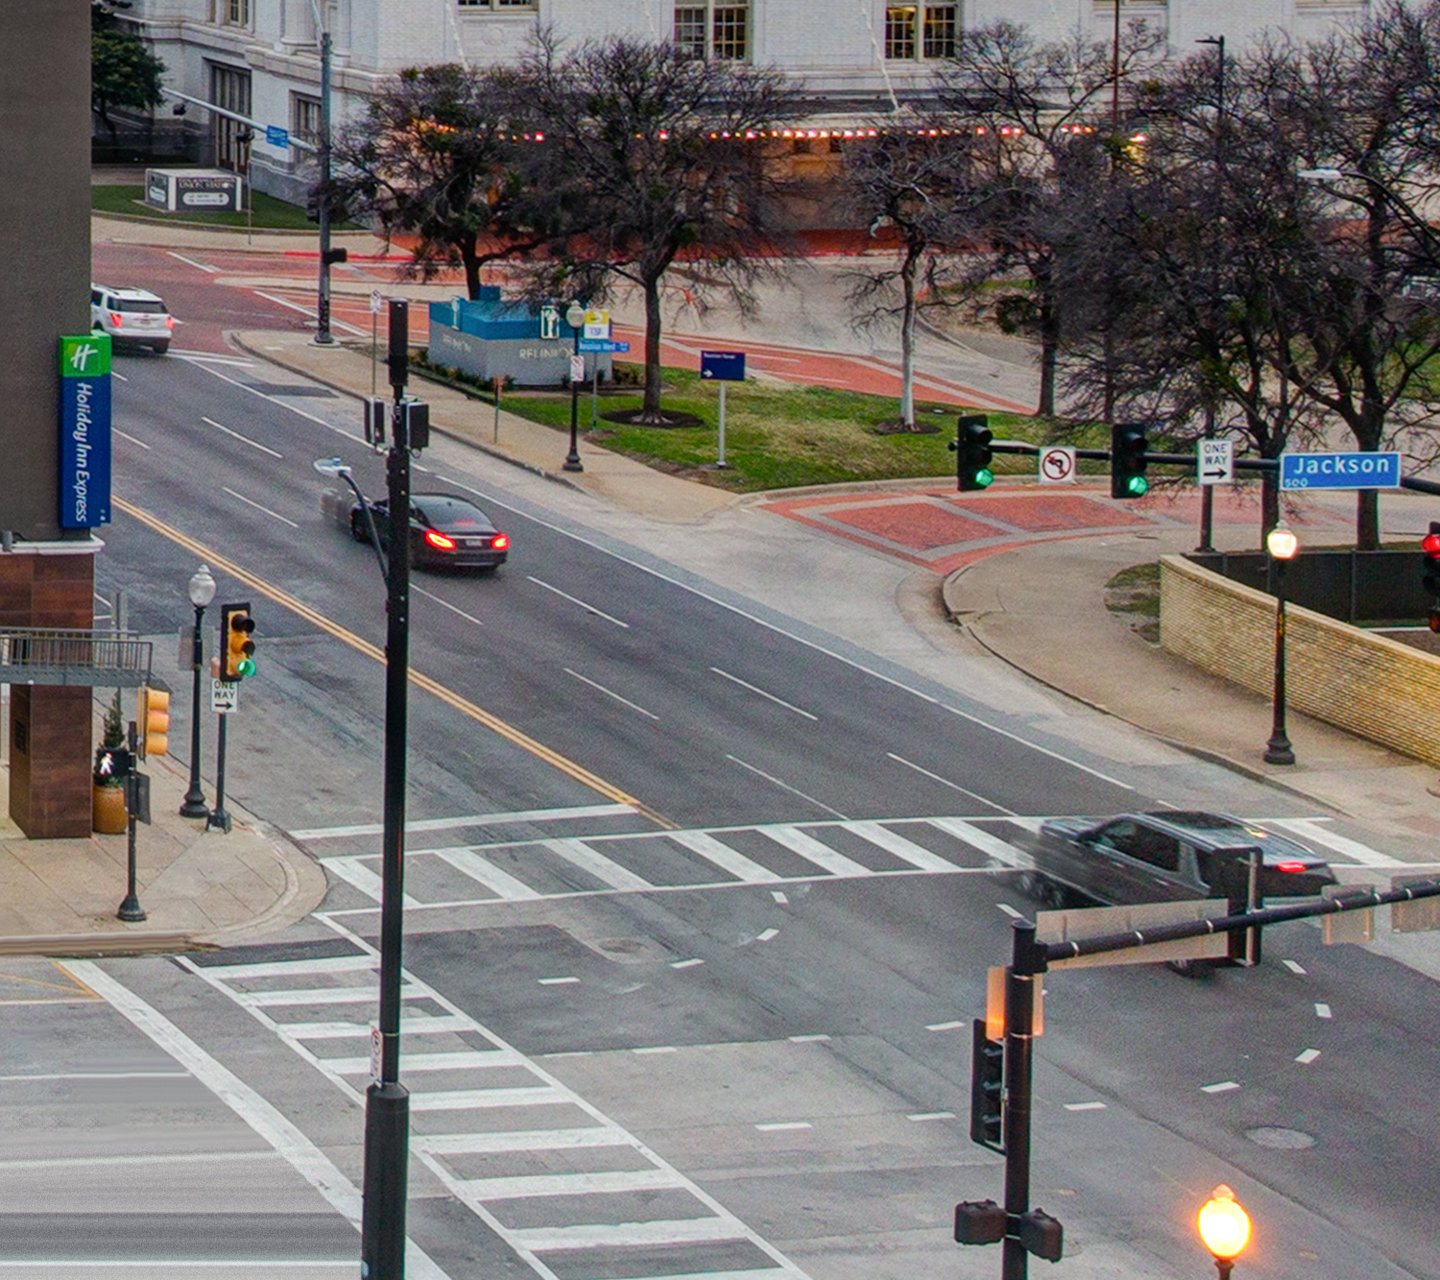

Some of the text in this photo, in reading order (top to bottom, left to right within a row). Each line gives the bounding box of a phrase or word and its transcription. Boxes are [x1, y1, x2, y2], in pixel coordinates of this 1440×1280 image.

[73, 382, 92, 522] Holiday Inn Express
[1204, 443, 1227, 454] ONE
[1205, 455, 1228, 465] WAY
[1293, 456, 1389, 474] Jackson
[214, 680, 235, 689] ONE
[214, 691, 235, 699] WAY
